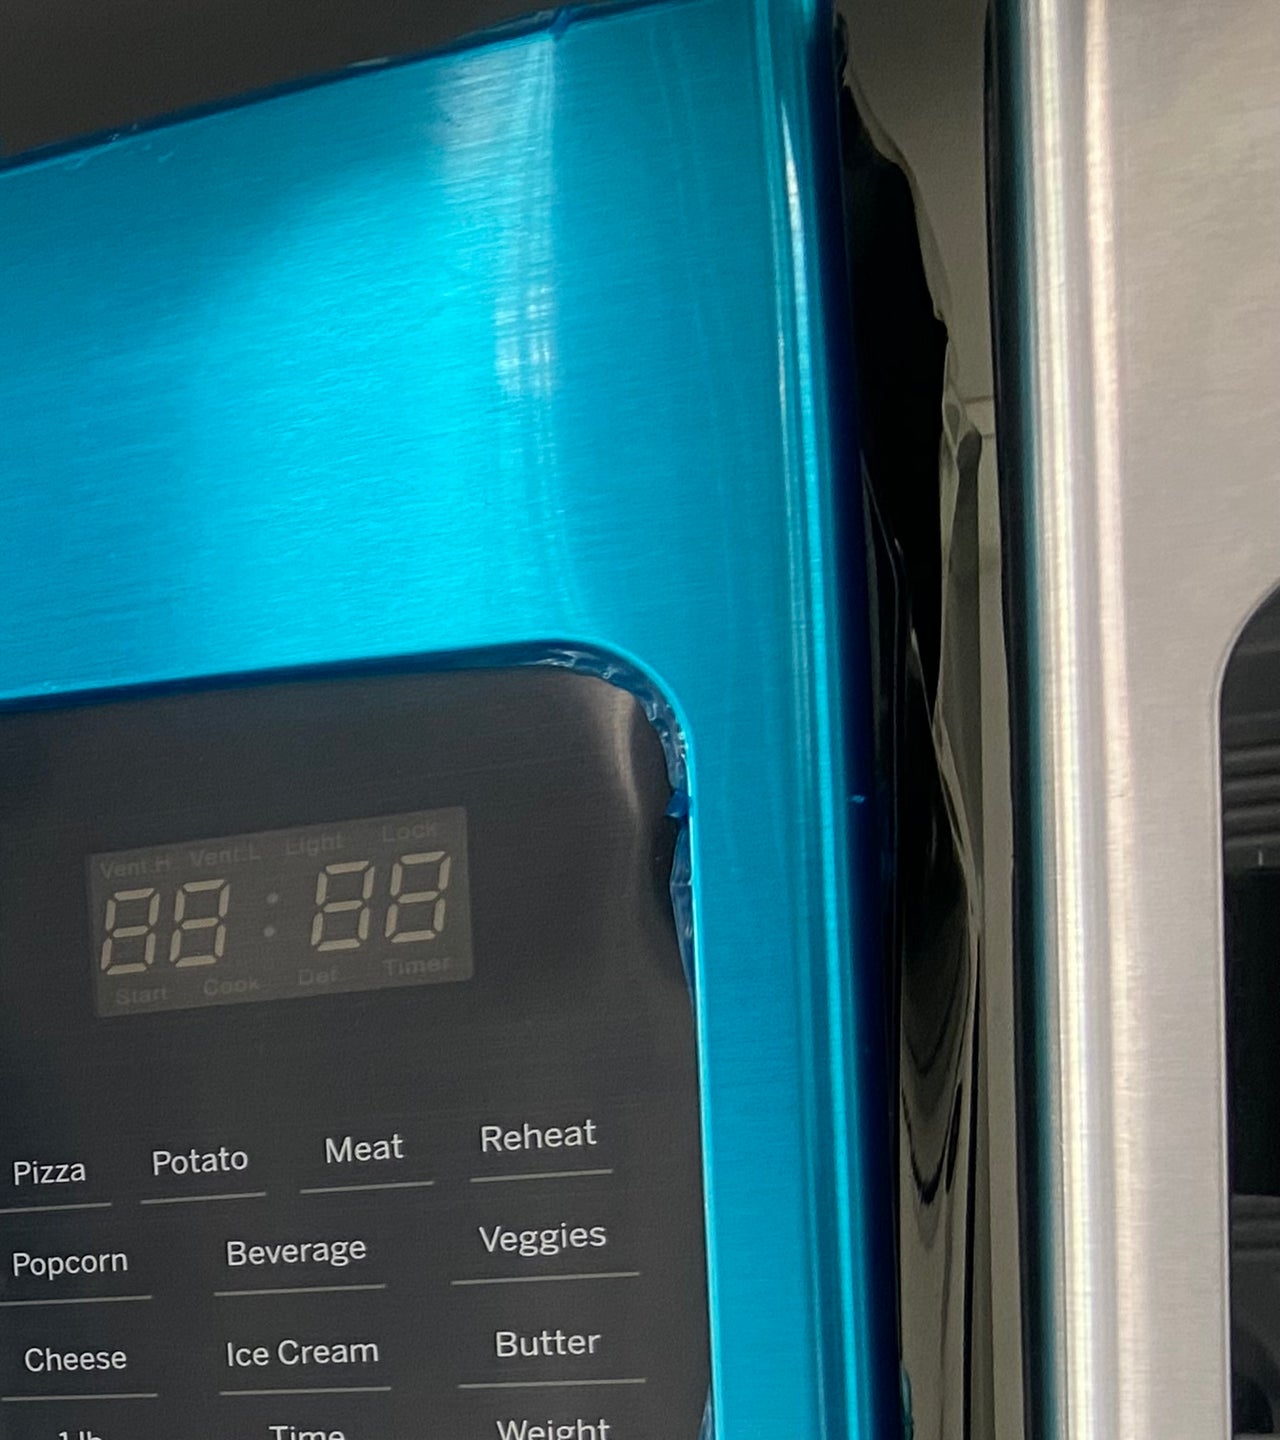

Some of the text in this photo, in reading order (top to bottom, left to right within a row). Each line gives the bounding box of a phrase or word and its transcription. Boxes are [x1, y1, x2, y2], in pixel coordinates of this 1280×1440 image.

[203, 975, 259, 996] Cook
[326, 1134, 403, 1163] Meat
[482, 1120, 597, 1152] Reheat
[14, 1161, 85, 1185] Pizza
[152, 1148, 248, 1175] Potato
[479, 1223, 606, 1256] Veggies
[14, 1253, 127, 1280] Popcorn
[228, 1241, 366, 1266] Beverage
[228, 1340, 378, 1366] Ice Cream
[497, 1330, 600, 1356] Butter
[25, 1348, 126, 1371] Cheese
